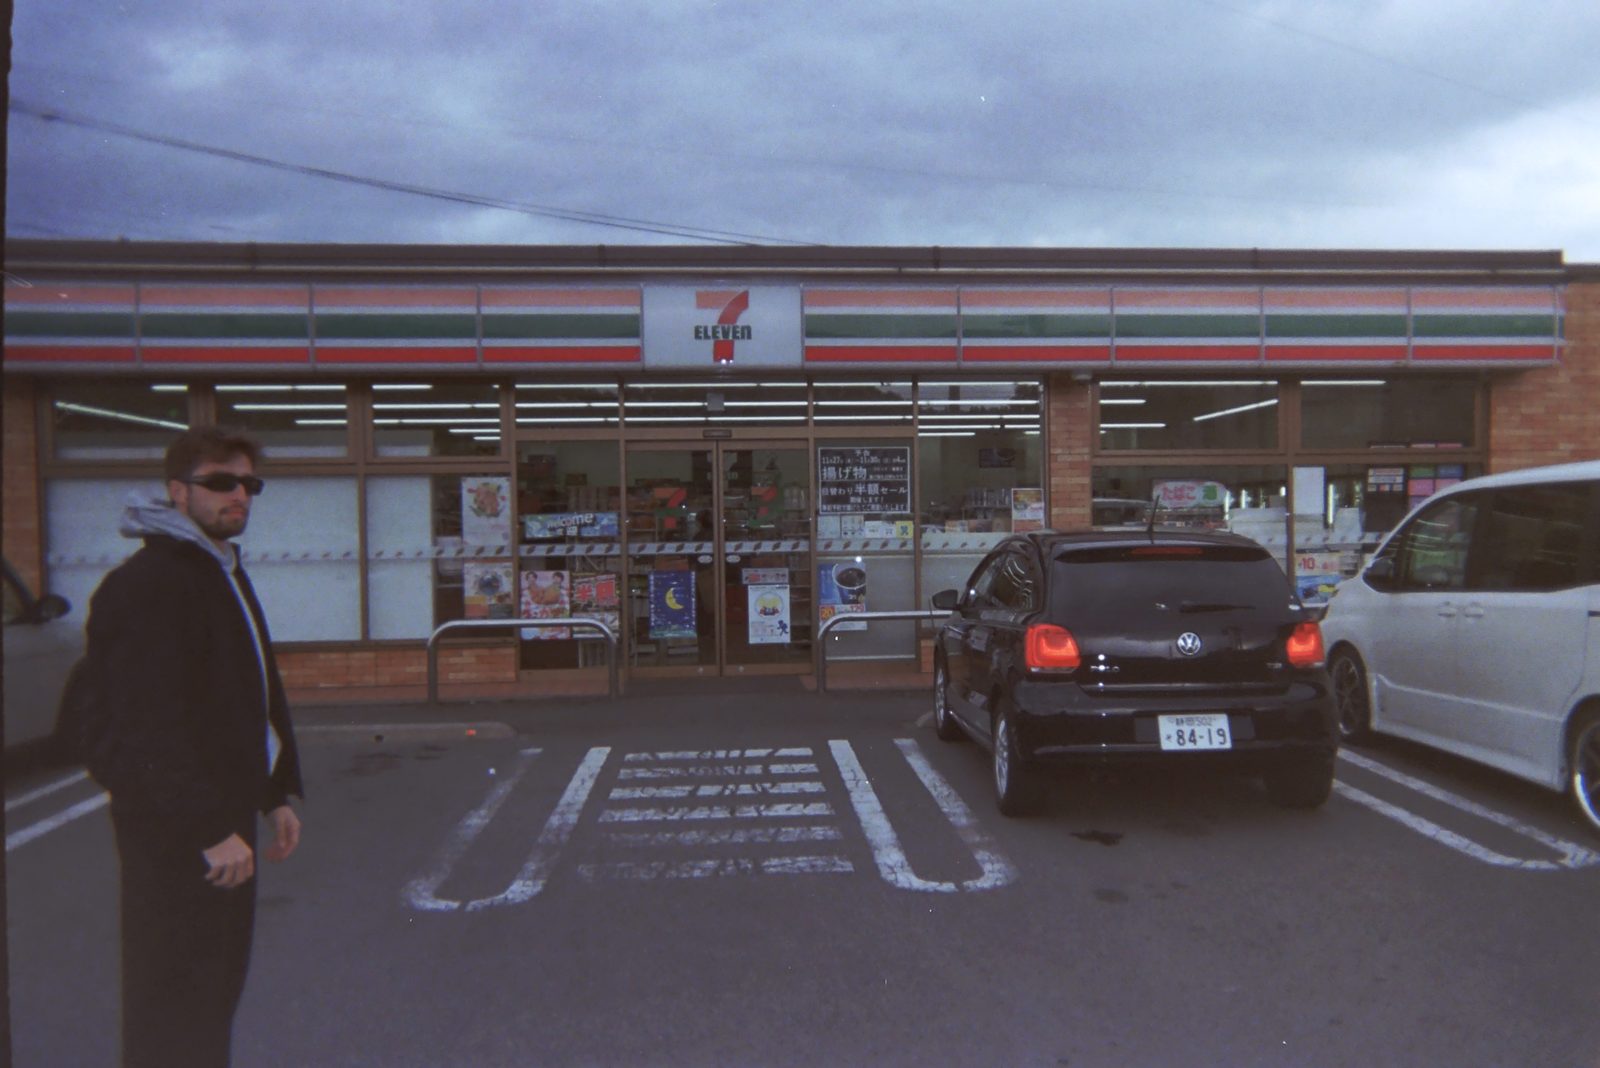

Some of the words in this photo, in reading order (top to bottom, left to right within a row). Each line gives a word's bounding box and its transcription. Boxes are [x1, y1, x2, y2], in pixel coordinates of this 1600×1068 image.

[694, 325, 752, 340] ELEVEN
[696, 290, 749, 362] 7
[822, 466, 867, 480] 揚げ物
[1176, 728, 1227, 746] 84-19
